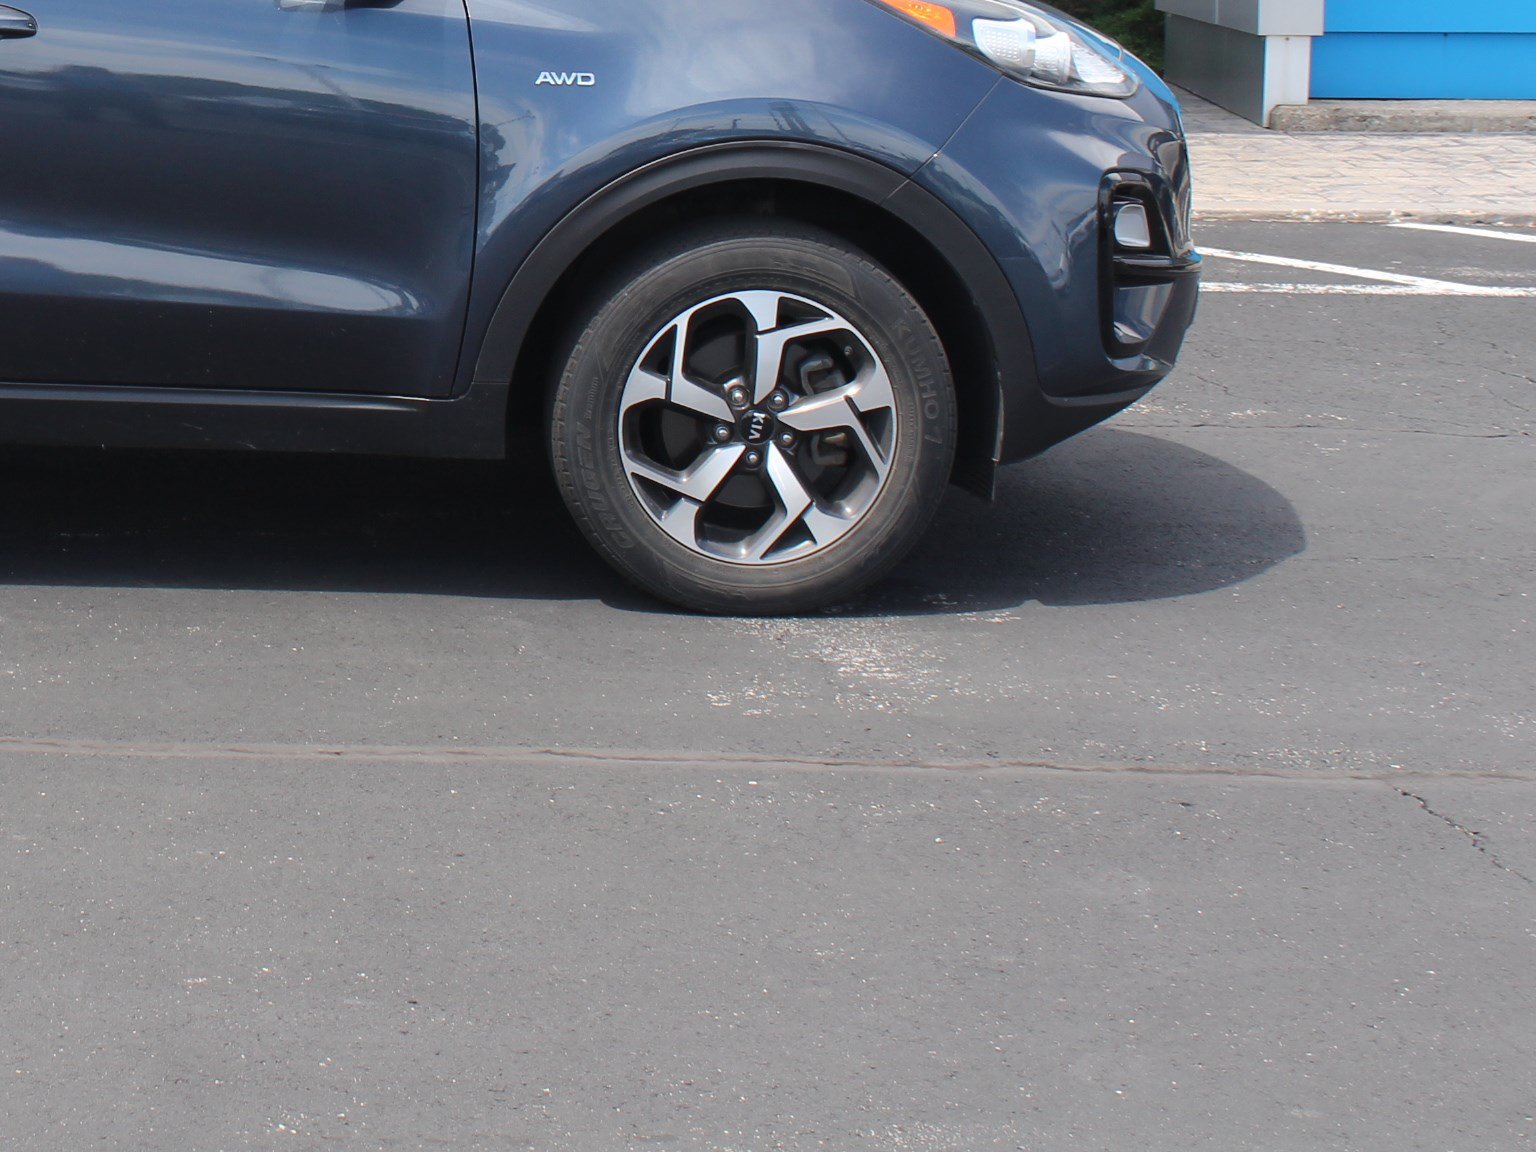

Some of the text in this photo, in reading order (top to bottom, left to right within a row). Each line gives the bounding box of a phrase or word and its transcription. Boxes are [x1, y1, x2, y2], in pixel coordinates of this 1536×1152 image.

[535, 71, 596, 86] AWD
[891, 319, 940, 420] KUMHO
[748, 412, 767, 440] KIA
